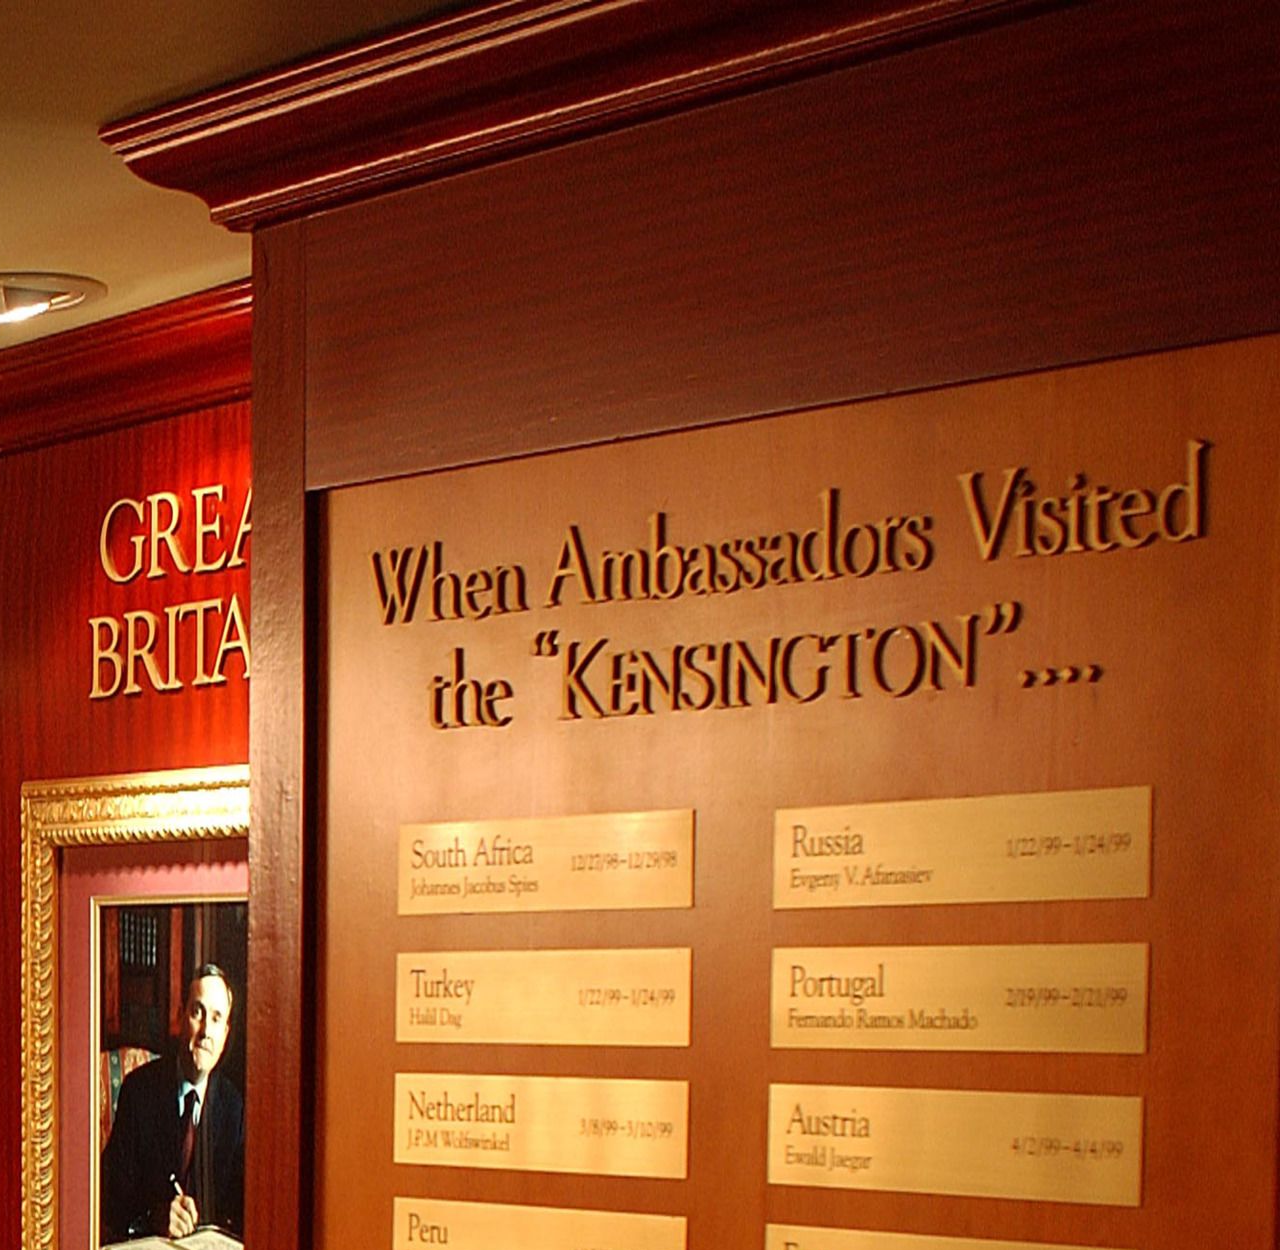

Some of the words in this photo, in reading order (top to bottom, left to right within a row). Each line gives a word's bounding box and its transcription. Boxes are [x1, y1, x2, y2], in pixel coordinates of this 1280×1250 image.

[370, 541, 526, 626] When
[547, 488, 933, 610] Ambassadors
[957, 438, 1212, 562] Visited
[428, 649, 515, 730] the
[410, 836, 468, 870] South
[473, 834, 534, 867] Africa
[791, 823, 866, 860] Russia
[409, 967, 475, 1005] Turkey
[788, 963, 886, 1006] Portugal
[786, 1007, 854, 1032] Fernando
[855, 1007, 906, 1031] Ramos
[907, 1007, 980, 1032] Machado
[407, 1090, 517, 1126] Netherland
[785, 1102, 872, 1140] Austria
[406, 1211, 449, 1246] Peru
